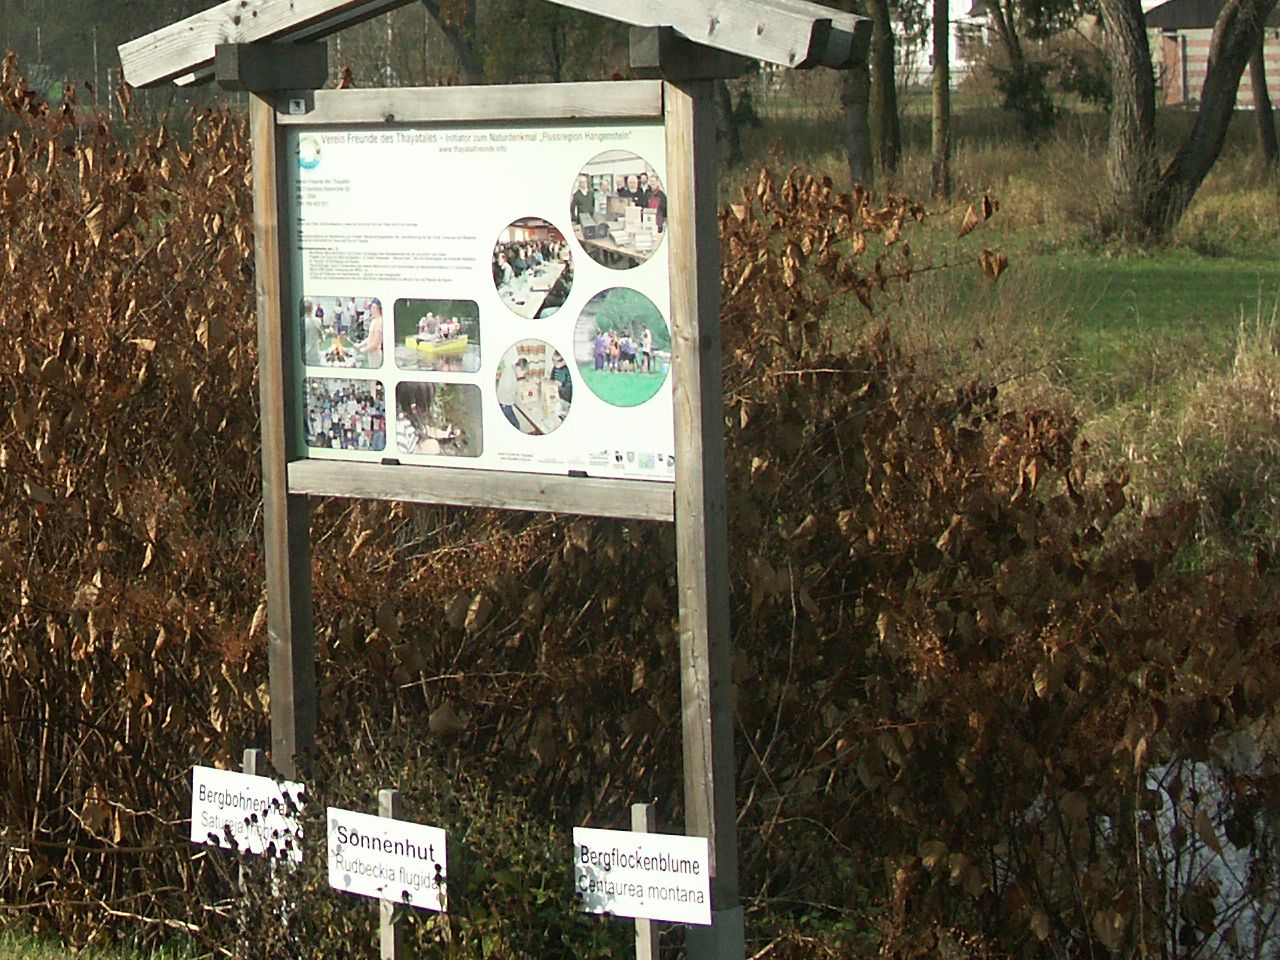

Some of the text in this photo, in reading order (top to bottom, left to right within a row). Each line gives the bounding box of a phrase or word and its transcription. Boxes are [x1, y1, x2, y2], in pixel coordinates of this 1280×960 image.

[321, 133, 345, 144] Verein
[347, 132, 377, 144] Freunde
[380, 132, 394, 144] des
[473, 135, 487, 143] zum
[489, 132, 537, 143] Naturdenkmal
[337, 825, 436, 862] Sonnenhut
[335, 852, 396, 881] Rudbeckia
[580, 844, 701, 875] Bergflockenblume
[578, 874, 704, 904] Centaurea montana
